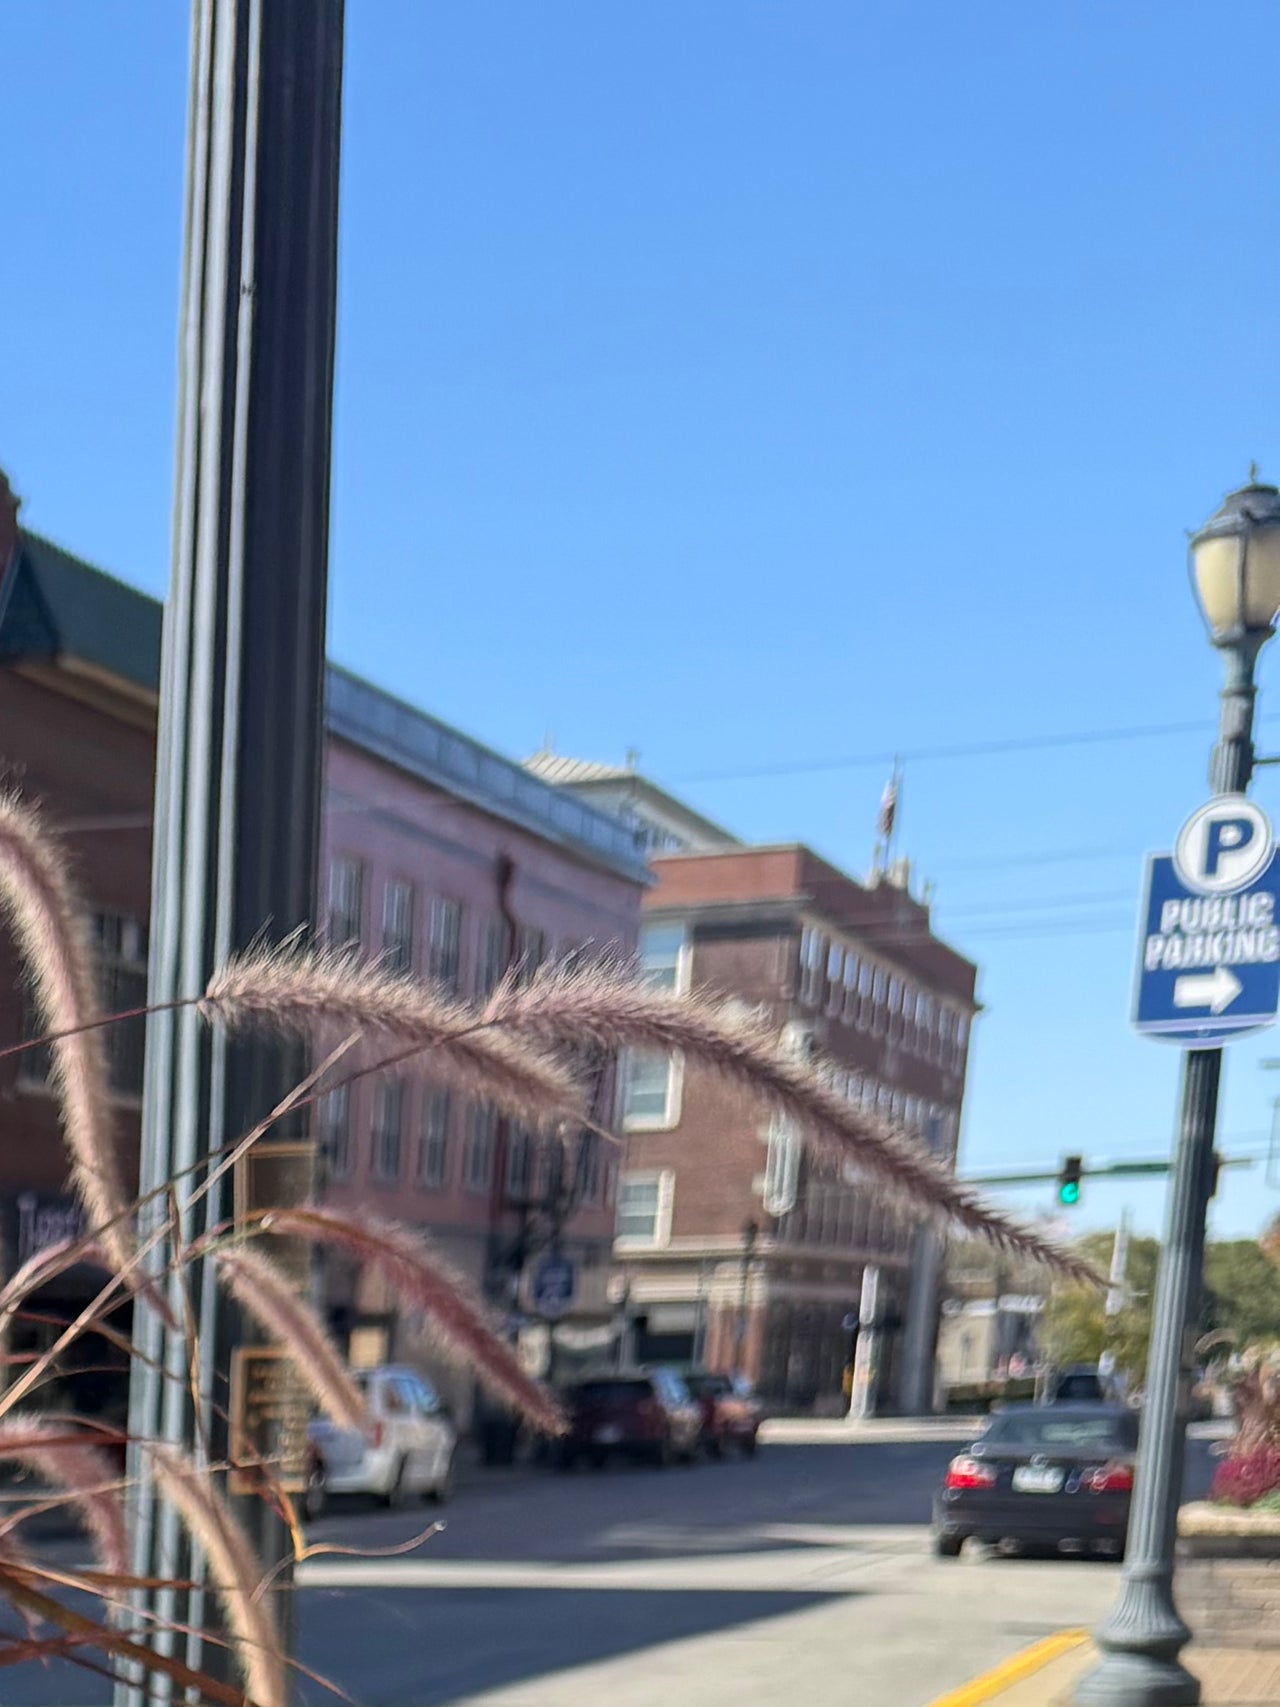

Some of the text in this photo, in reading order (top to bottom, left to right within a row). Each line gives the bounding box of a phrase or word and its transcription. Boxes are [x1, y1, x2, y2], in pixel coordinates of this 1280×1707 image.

[1205, 818, 1255, 876] P
[1160, 891, 1275, 934] PUBLIC
[1144, 925, 1280, 972] PARKING
